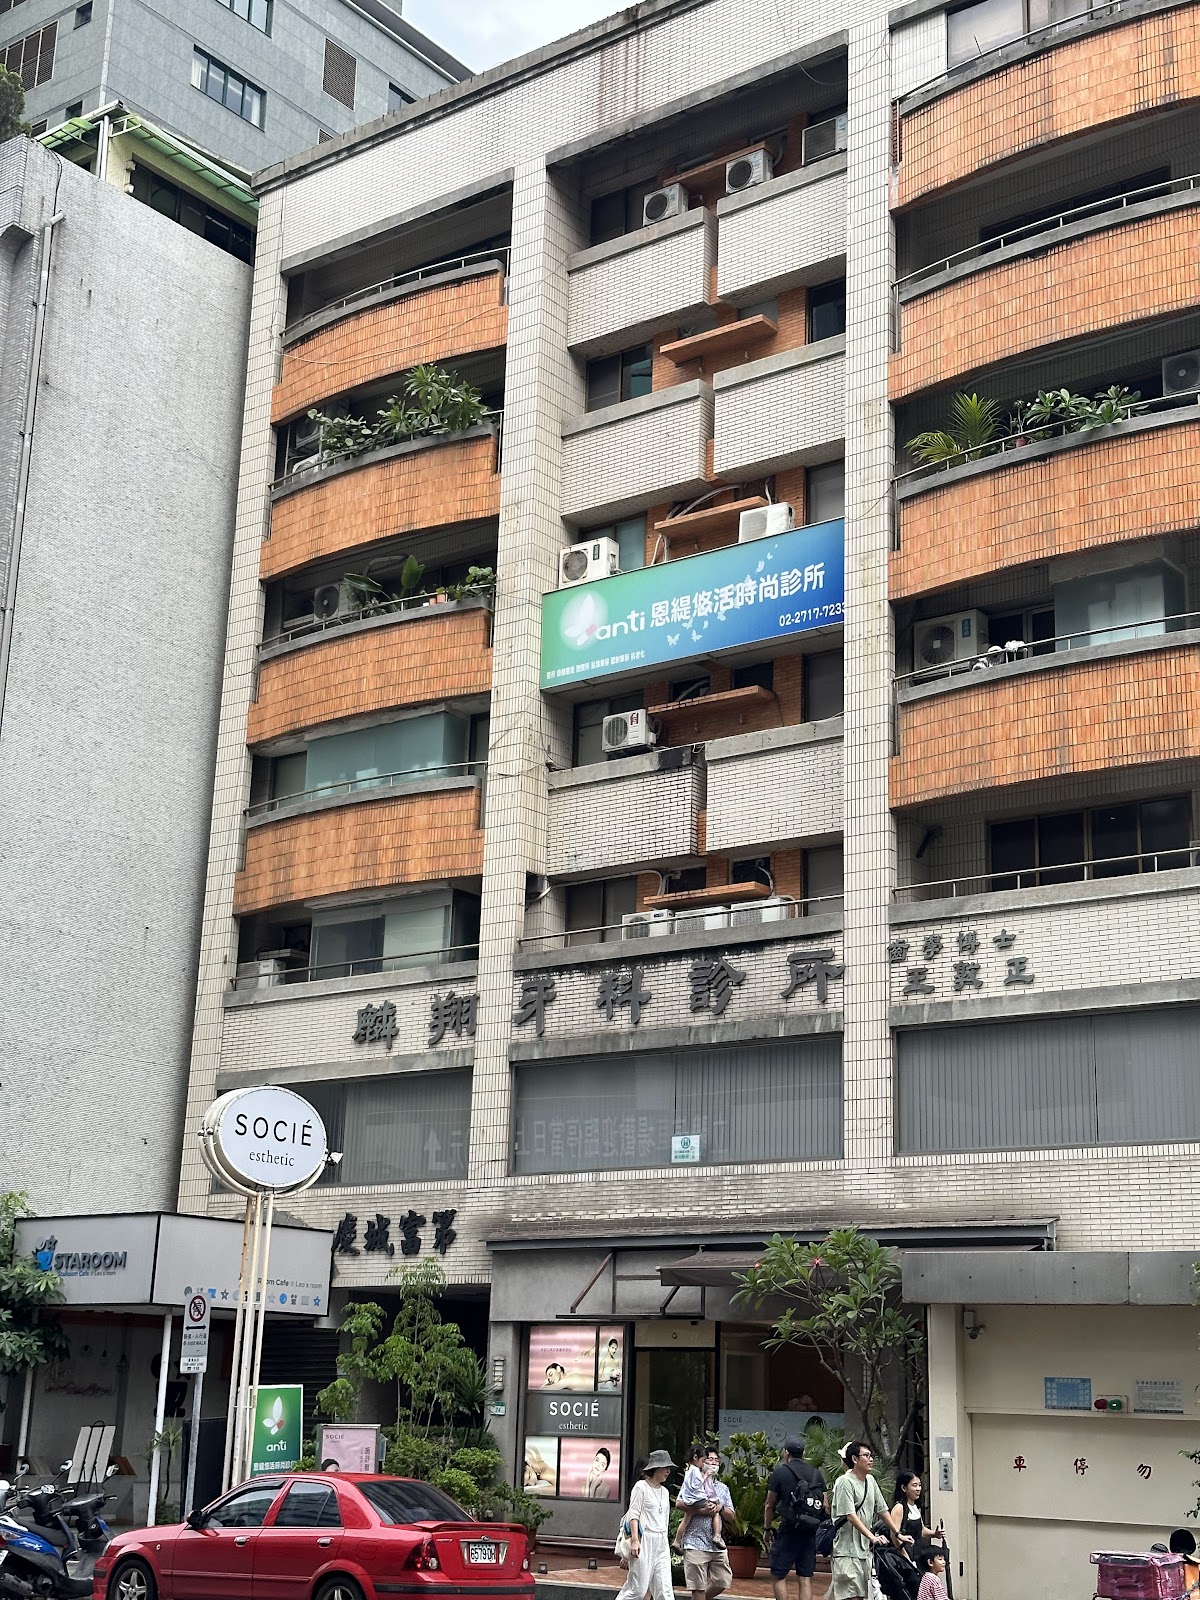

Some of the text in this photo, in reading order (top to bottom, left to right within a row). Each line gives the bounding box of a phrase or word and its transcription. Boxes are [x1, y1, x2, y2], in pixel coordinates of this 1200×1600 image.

[594, 562, 825, 642] anti 恩緹悠活時尚診所
[235, 1113, 313, 1146] SOCIÉ
[249, 1150, 295, 1167] esthetic
[54, 1251, 128, 1270] STAROOM
[276, 1278, 289, 1287] Cafe
[549, 1399, 600, 1417] SOCIÉ
[558, 1420, 589, 1431] esthetic
[266, 1440, 287, 1452] anti
